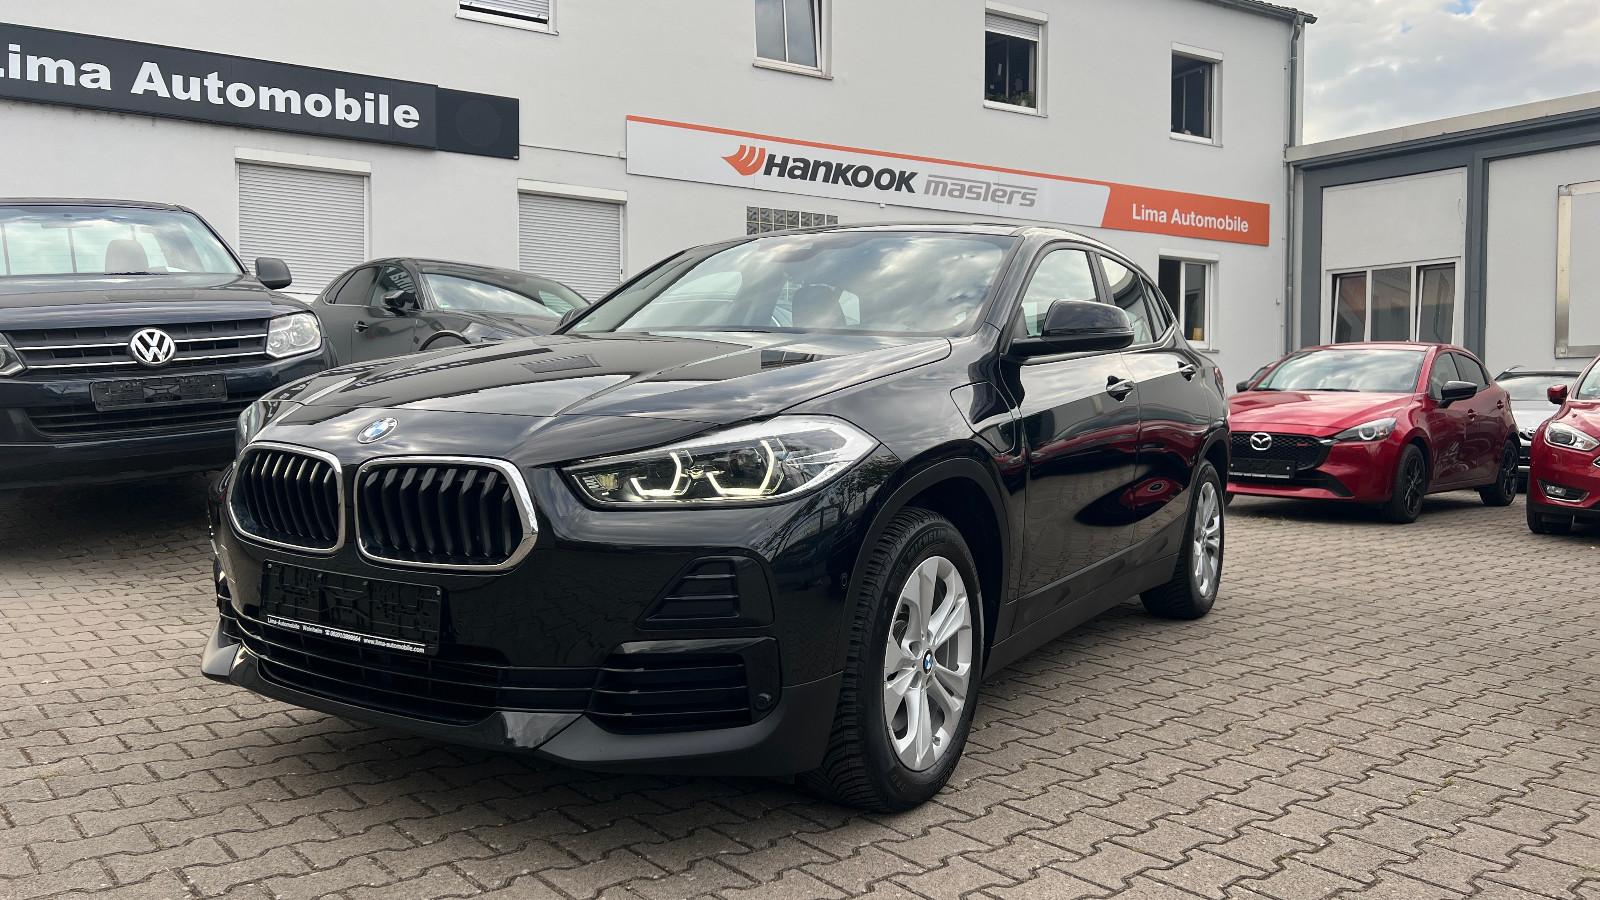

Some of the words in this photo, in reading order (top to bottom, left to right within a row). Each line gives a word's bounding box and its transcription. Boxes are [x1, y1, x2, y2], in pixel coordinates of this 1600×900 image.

[0, 43, 112, 91] ima
[130, 61, 420, 129] Automobile
[924, 174, 1038, 208] masters
[1132, 203, 1167, 224] Lima
[1170, 208, 1249, 233] Automobile
[130, 328, 175, 364] VW
